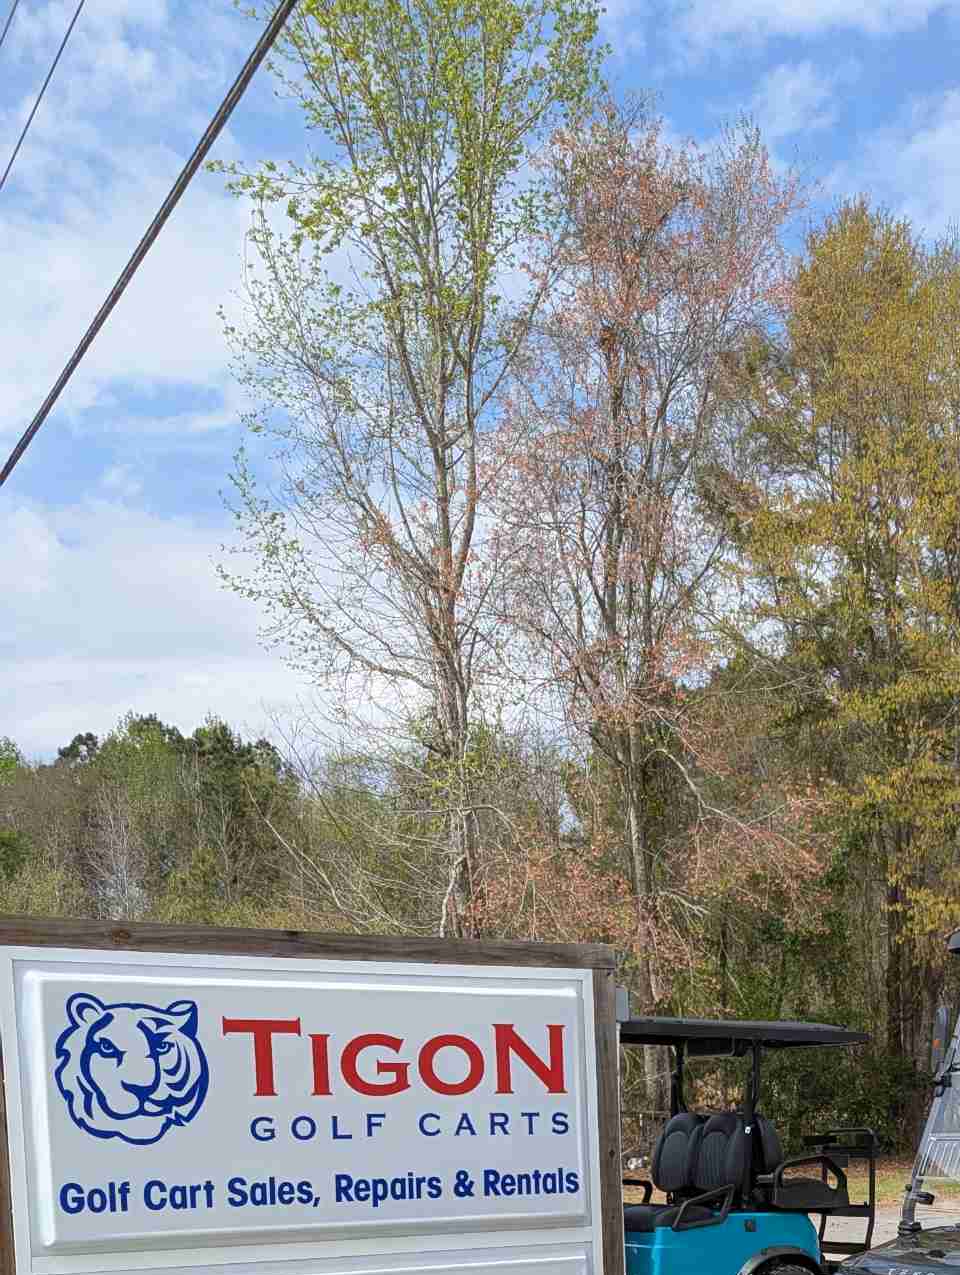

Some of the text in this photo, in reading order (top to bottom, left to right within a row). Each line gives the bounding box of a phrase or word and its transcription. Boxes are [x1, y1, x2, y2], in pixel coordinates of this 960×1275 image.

[222, 1016, 567, 1097] TIGON
[250, 1112, 570, 1141] GOLF CARTS
[59, 1168, 580, 1214] Golf Cart Sales, Repairs & Rentals
